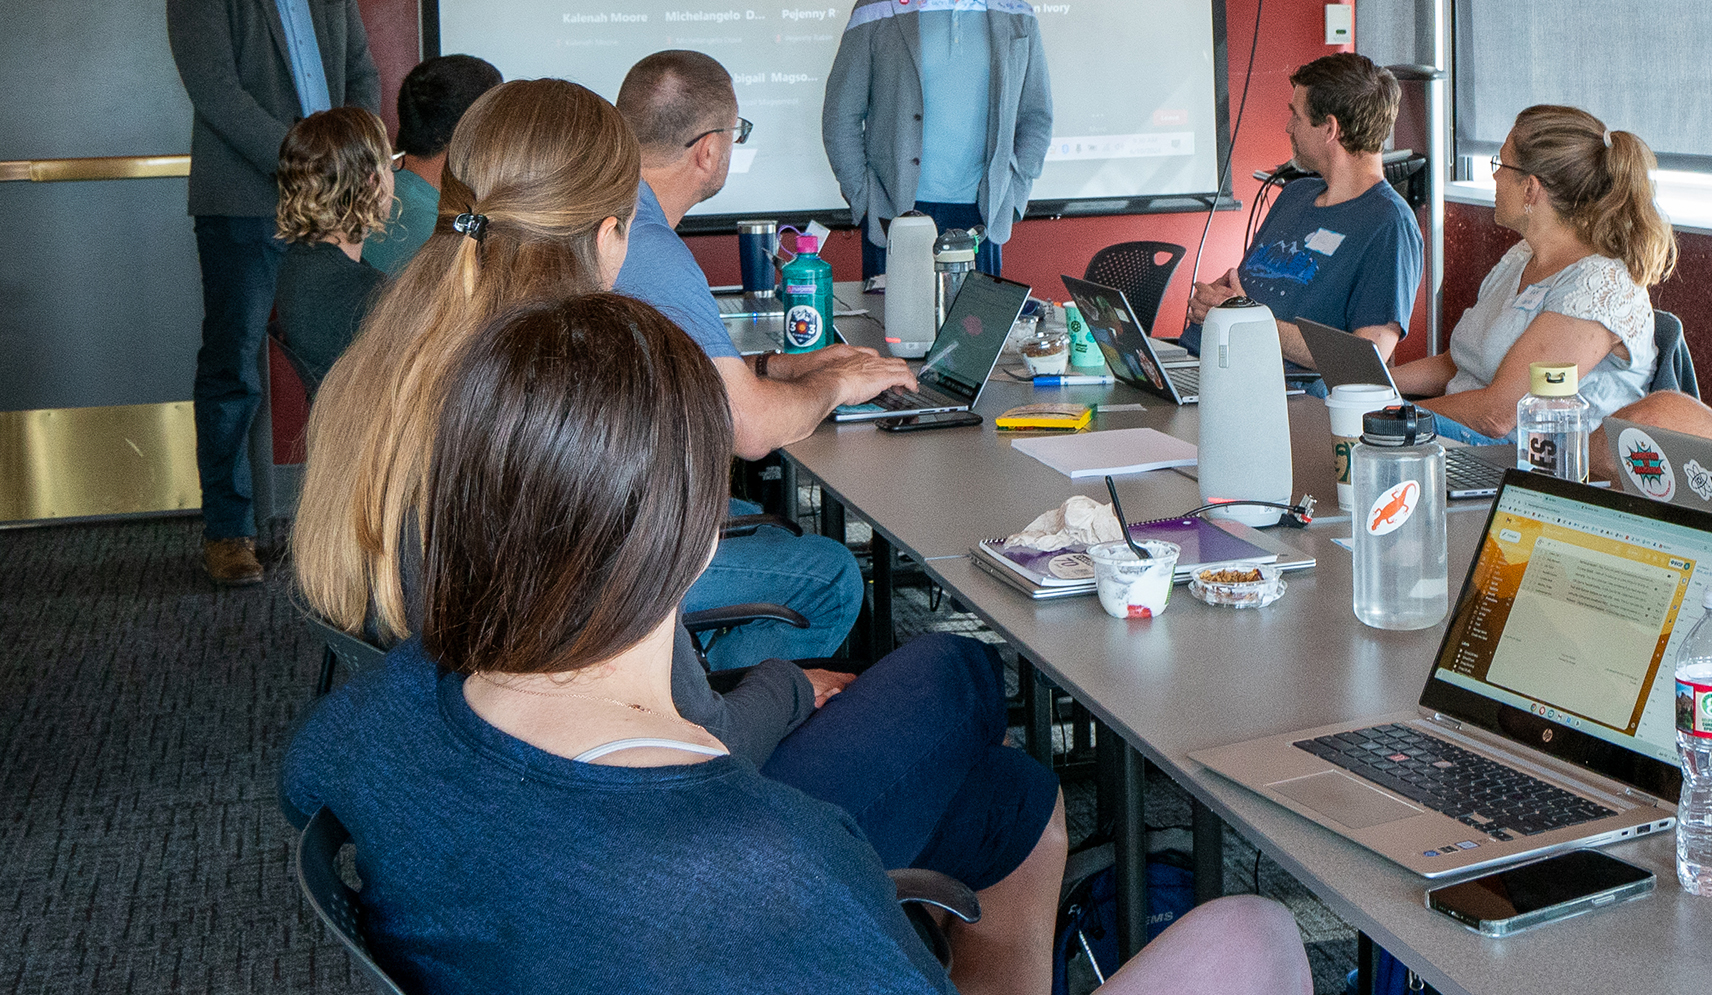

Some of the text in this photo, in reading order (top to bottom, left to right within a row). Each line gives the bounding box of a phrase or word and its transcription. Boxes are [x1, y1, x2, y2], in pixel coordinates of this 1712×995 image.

[781, 7, 827, 22] Pejenny
[1043, 2, 1071, 16] Ivory
[562, 11, 648, 24] Kalenah Moore
[665, 10, 741, 24] Michelangelo
[770, 71, 818, 85] Magso...
[1530, 437, 1557, 476] ES
